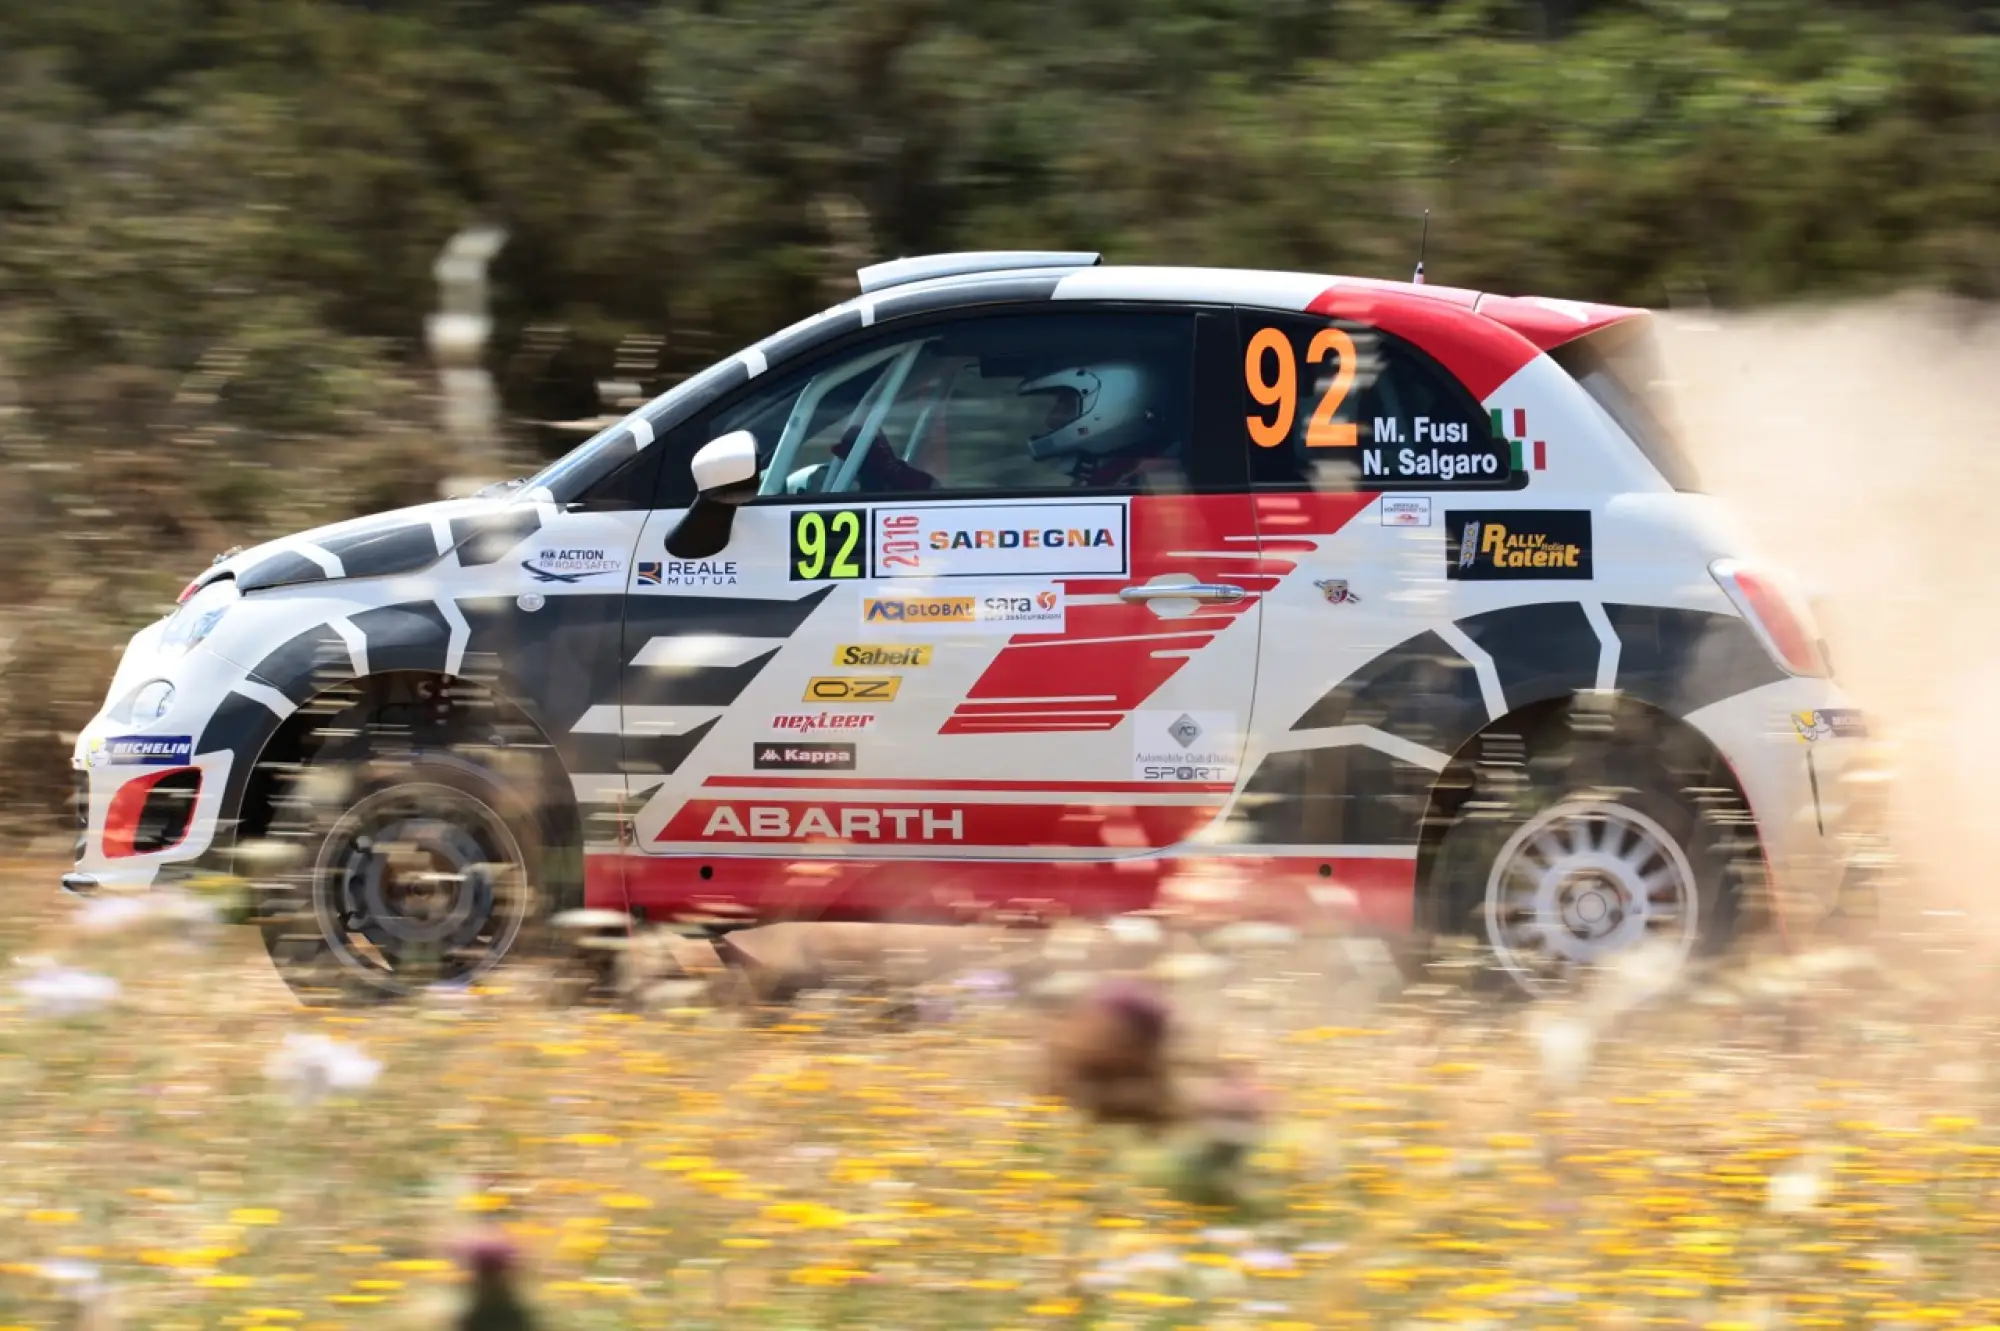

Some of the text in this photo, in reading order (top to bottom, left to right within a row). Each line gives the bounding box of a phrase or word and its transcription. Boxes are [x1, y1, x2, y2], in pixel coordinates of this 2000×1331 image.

[1244, 326, 1358, 448] 92
[1374, 416, 1406, 443] M.
[1363, 448, 1498, 480] N. Salgaro
[797, 511, 860, 579] 92
[883, 515, 920, 568] 2016
[929, 528, 1115, 550] SARDEGNA
[559, 549, 604, 560] ACTION
[585, 560, 621, 569] SAFETY
[667, 562, 737, 576] REALE
[667, 577, 737, 585] MUTUA
[906, 603, 971, 617] GLOBAL
[843, 646, 922, 665] Sabelt
[113, 743, 190, 754] MICHELIN
[784, 749, 851, 764] Kappa
[1144, 766, 1226, 780] SPORT
[702, 806, 964, 840] ABARTH
